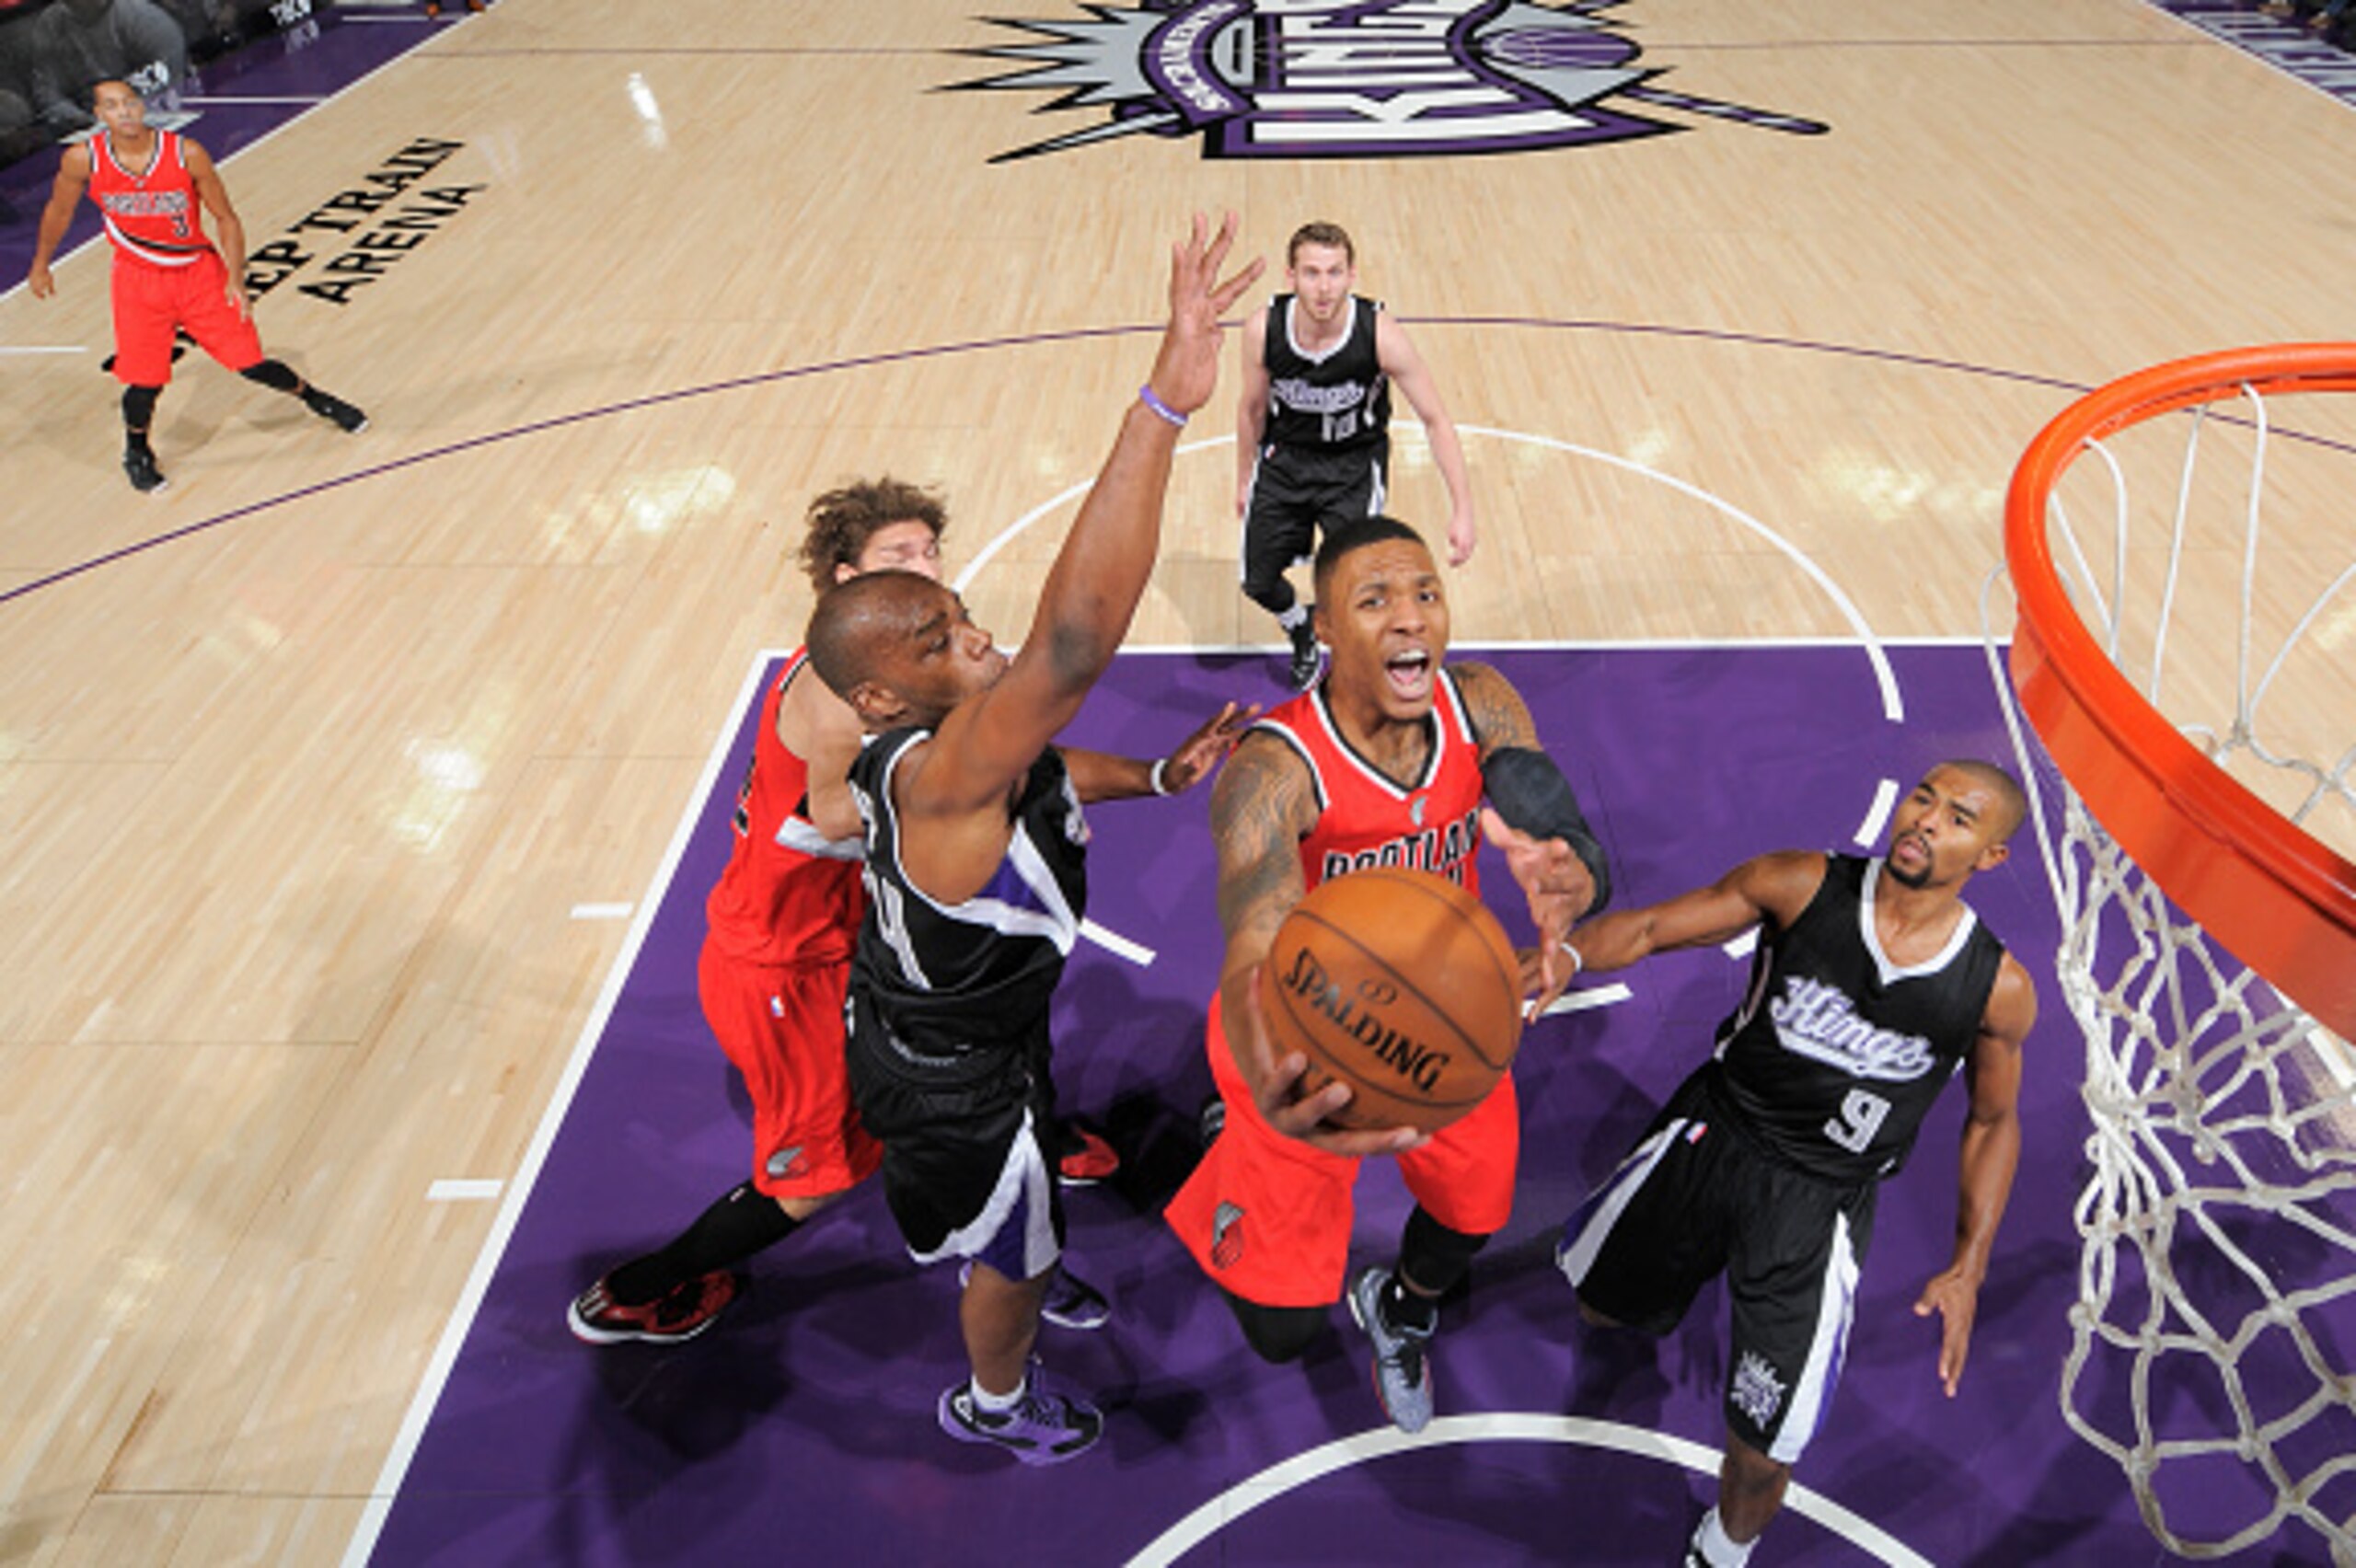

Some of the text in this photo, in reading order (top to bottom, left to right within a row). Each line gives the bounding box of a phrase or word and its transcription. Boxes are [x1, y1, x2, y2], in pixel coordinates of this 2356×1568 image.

[169, 214, 189, 237] 3
[285, 138, 466, 234] TRAIN
[297, 183, 488, 305] ARENA
[1283, 946, 1451, 1093] SPALDING
[1771, 975, 1934, 1082] Kings
[1822, 1088, 1892, 1154] 9
